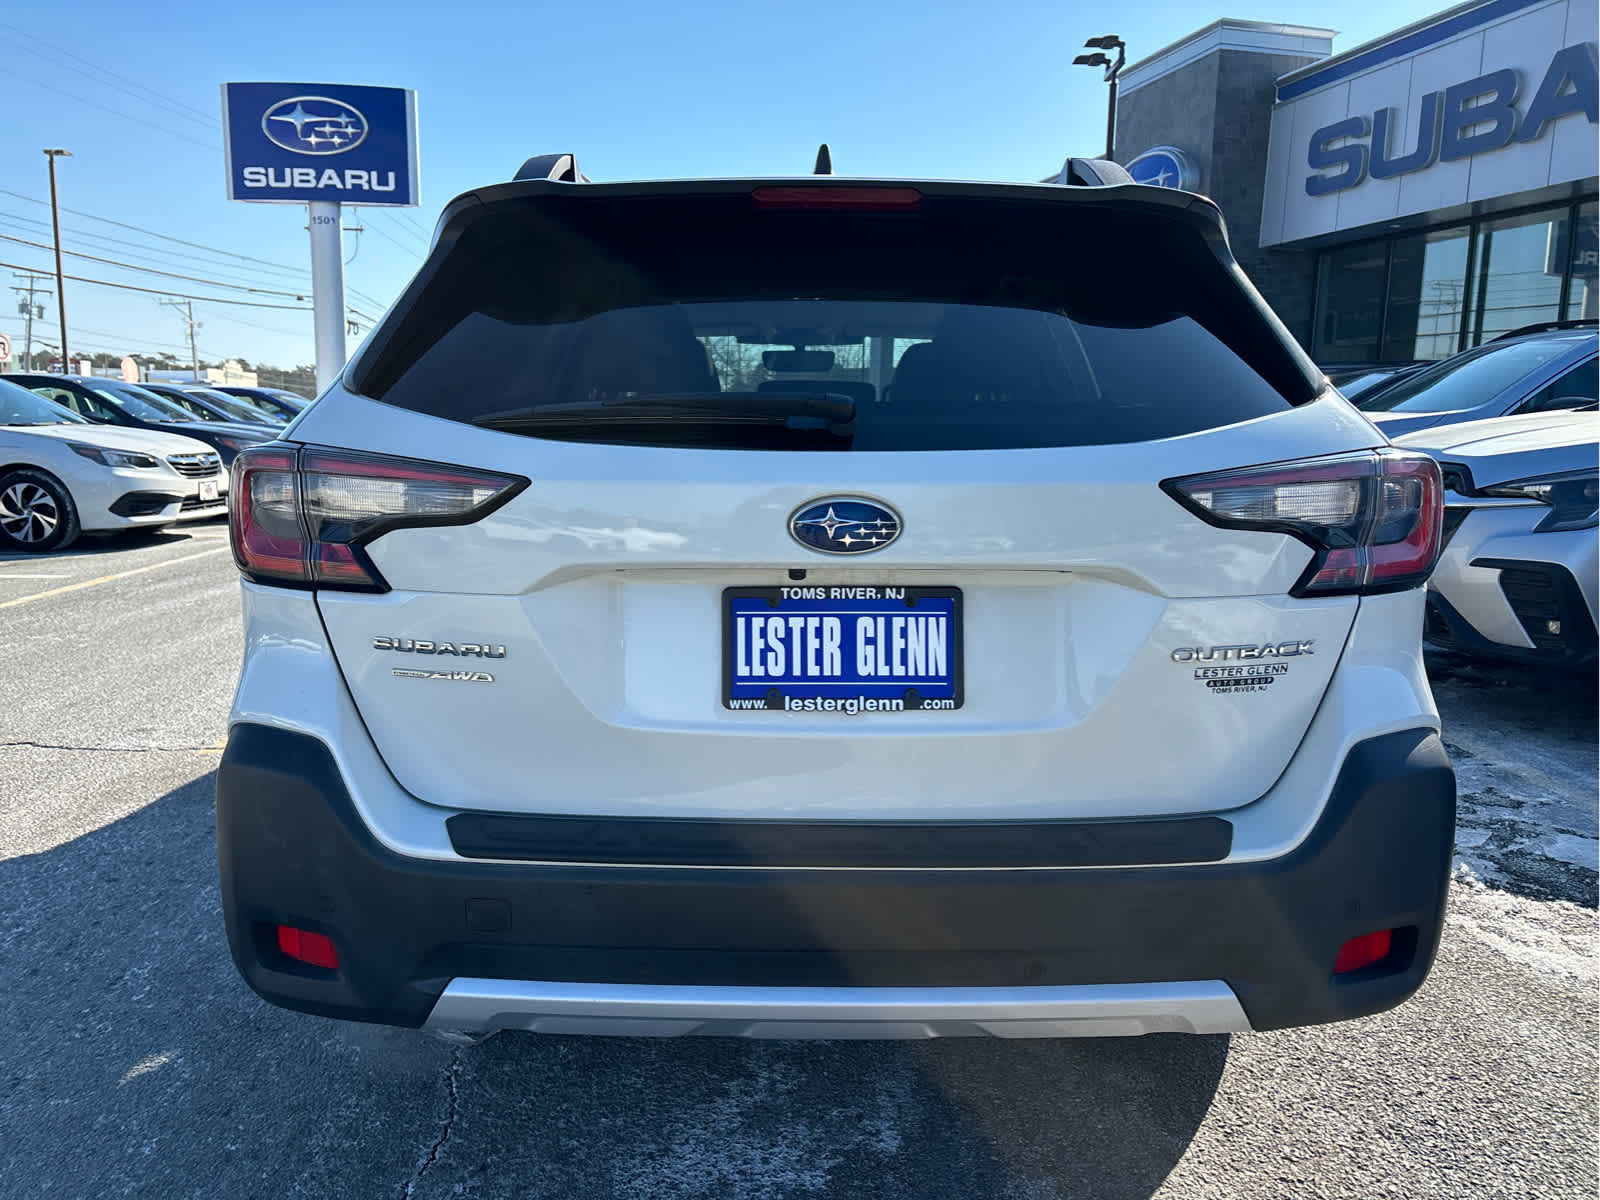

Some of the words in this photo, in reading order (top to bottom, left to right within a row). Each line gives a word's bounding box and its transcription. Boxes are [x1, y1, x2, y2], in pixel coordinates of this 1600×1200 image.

[243, 166, 397, 192] SUBARU
[781, 587, 826, 600] TOMS
[830, 587, 882, 601] RIVER,
[885, 587, 906, 600] NJ
[373, 635, 507, 659] SUBARU
[736, 616, 842, 677] LESTER
[856, 616, 948, 677] GLENN
[1171, 639, 1317, 663] OUTBACK
[1194, 667, 1243, 678] LESTER
[1247, 664, 1289, 675] GLENN
[1208, 679, 1235, 687] AUTO
[1240, 677, 1273, 686] GROUP
[784, 695, 904, 715] lesterglenn
